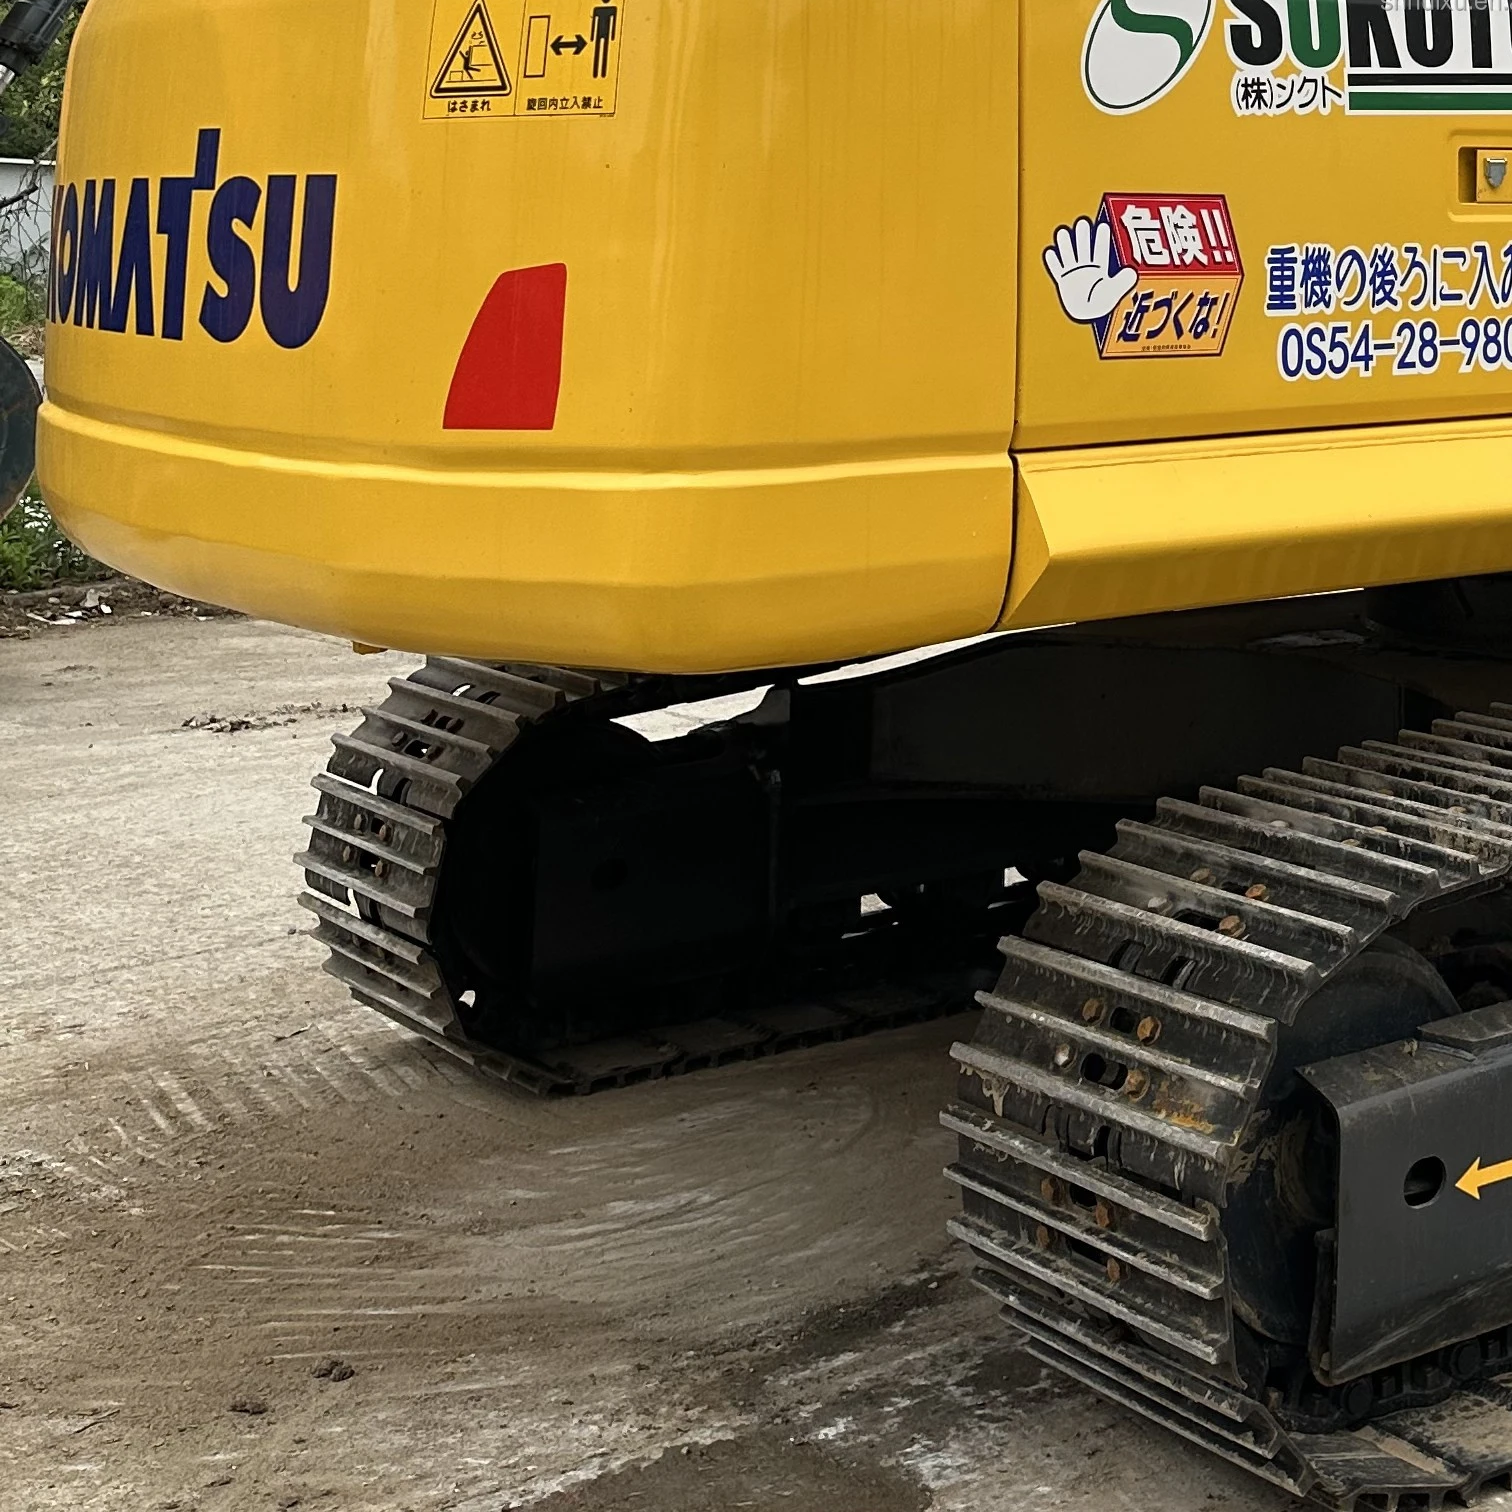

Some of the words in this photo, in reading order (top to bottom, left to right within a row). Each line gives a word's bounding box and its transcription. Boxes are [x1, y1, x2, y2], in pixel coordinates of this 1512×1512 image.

[447, 99, 492, 113] はさまれ
[526, 96, 604, 111] 旋回内立入禁止
